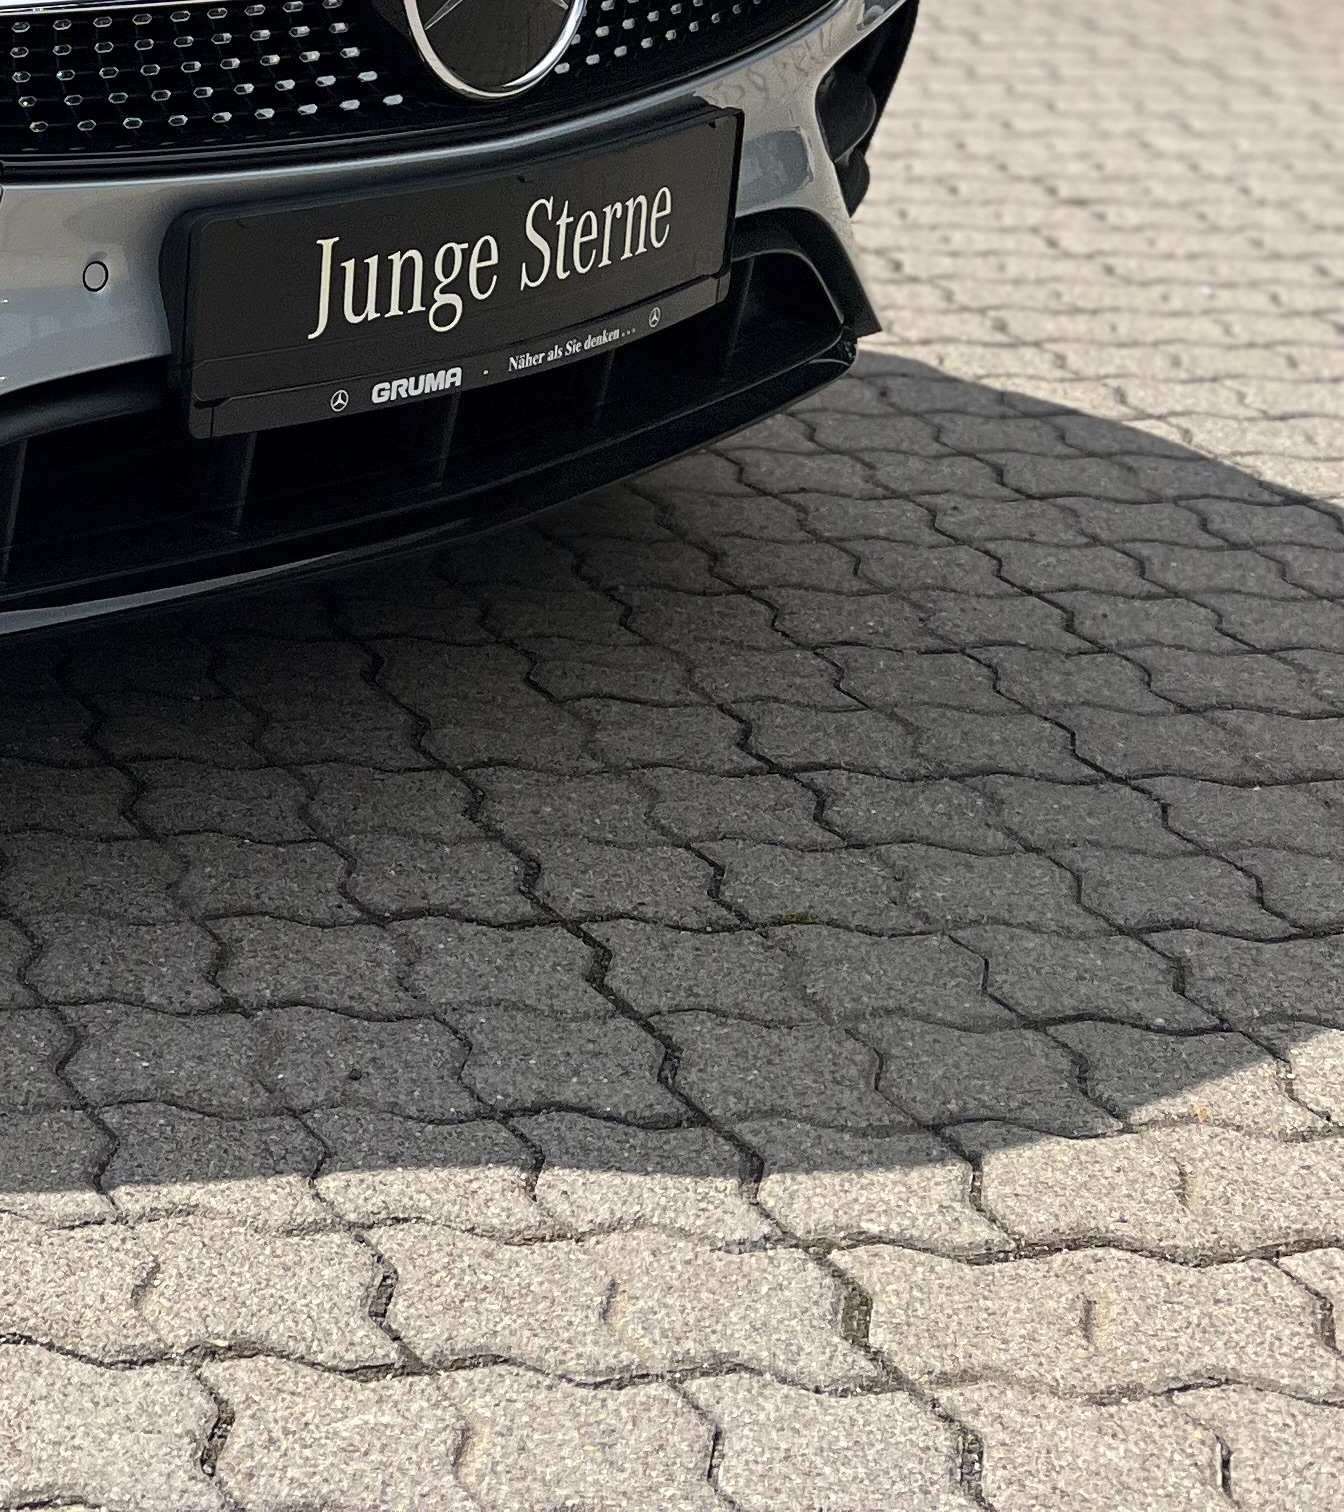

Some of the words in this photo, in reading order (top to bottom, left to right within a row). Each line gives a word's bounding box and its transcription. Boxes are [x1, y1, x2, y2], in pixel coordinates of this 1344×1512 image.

[307, 234, 498, 340] Junge
[520, 186, 673, 291] Sterne
[370, 366, 462, 404] GRUMA
[507, 351, 545, 372] Näher
[546, 345, 563, 362] als
[564, 339, 582, 357] Sie
